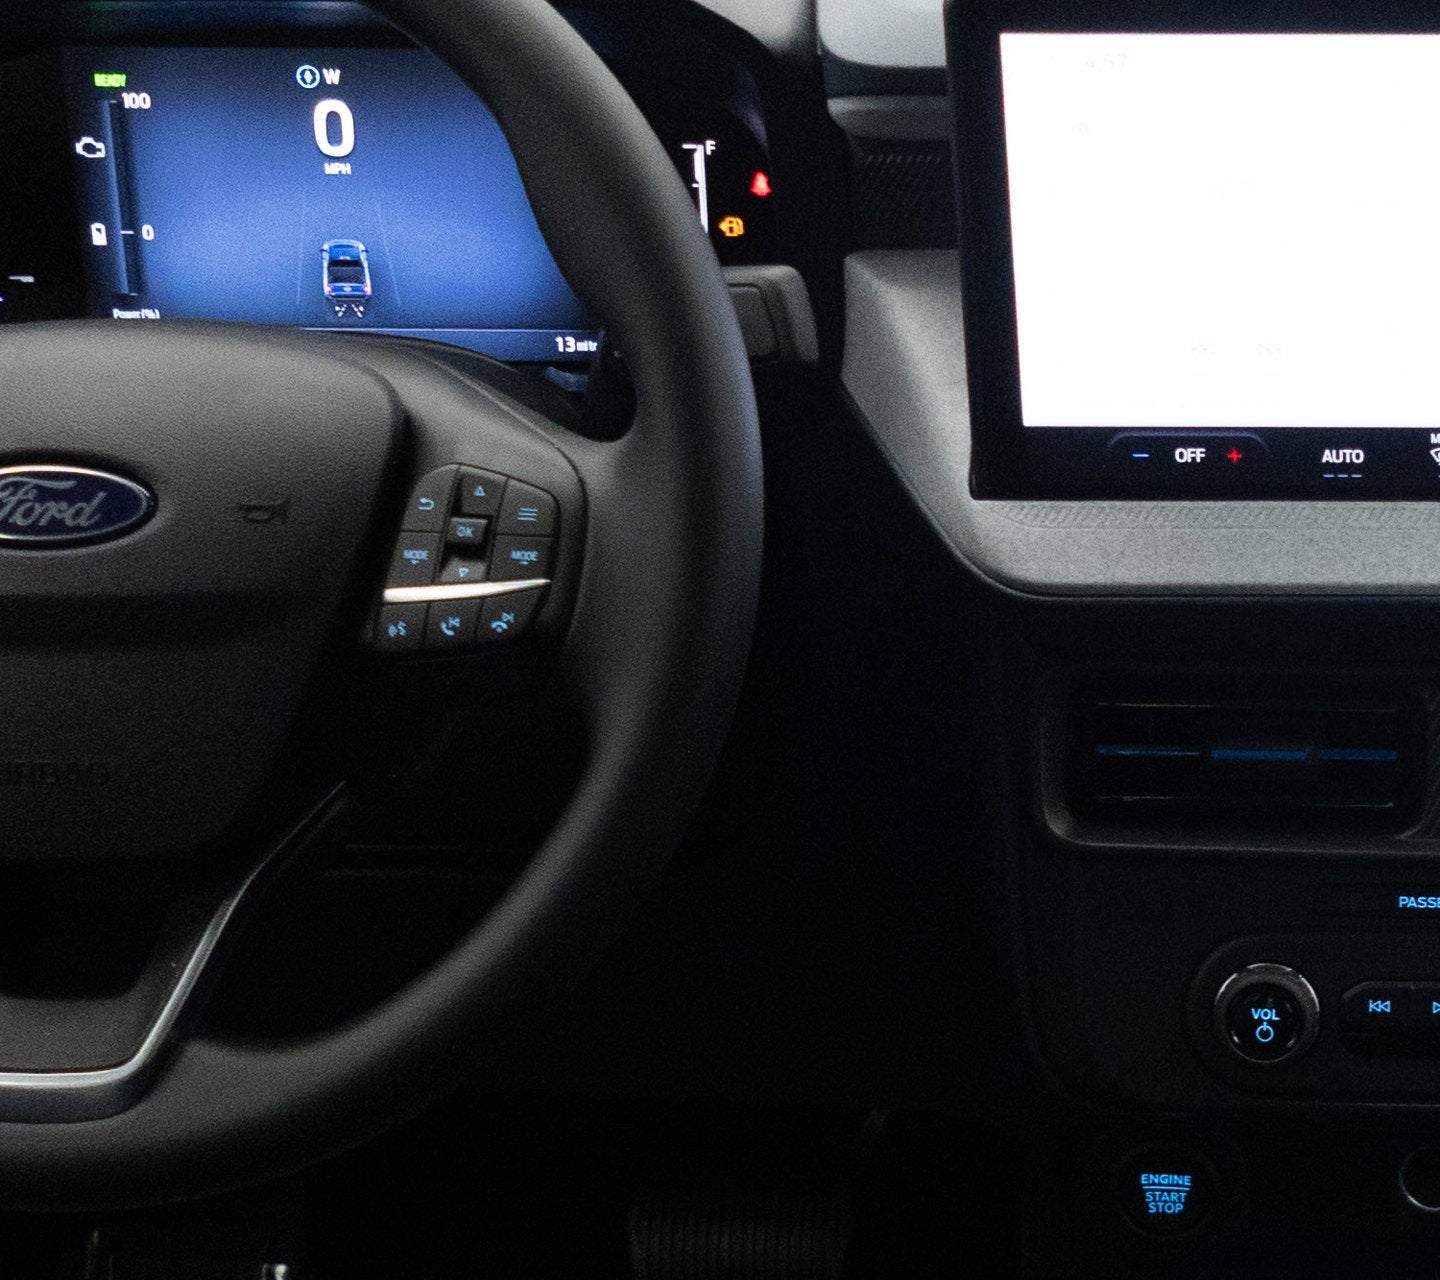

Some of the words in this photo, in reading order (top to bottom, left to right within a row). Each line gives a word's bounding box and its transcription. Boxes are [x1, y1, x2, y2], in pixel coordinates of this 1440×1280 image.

[322, 68, 340, 85] W
[121, 92, 151, 109] 100
[313, 99, 355, 157] 0
[706, 140, 716, 156] F
[324, 163, 352, 175] MPH
[141, 224, 155, 241] 0
[555, 336, 576, 353] 13
[1174, 448, 1206, 463] OFF
[1322, 448, 1364, 464] AUTO
[457, 526, 474, 538] OK
[403, 549, 429, 560] MODE
[511, 550, 539, 561] MODE
[1251, 1007, 1281, 1021] VOL
[1140, 1173, 1192, 1186] ENGINE
[1145, 1191, 1187, 1203] START
[1148, 1202, 1184, 1214] STOP
